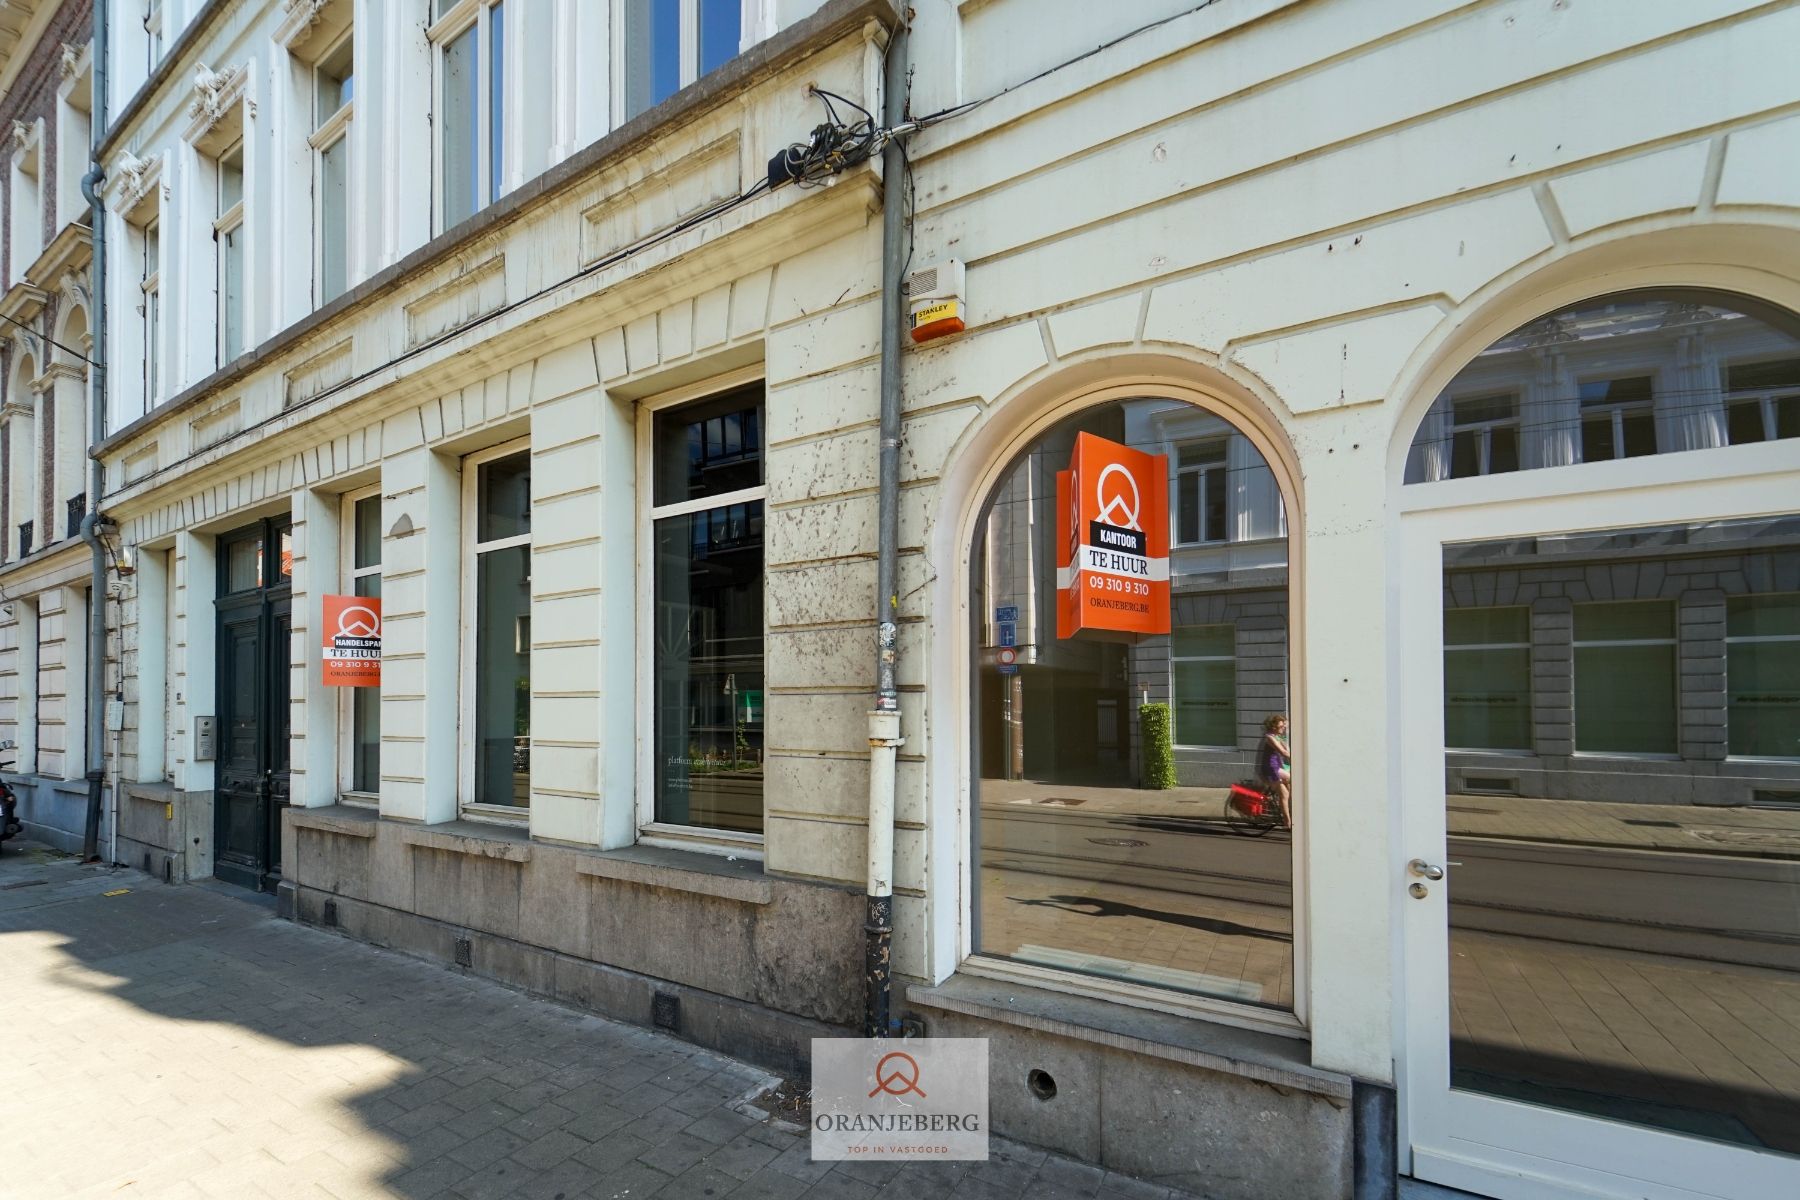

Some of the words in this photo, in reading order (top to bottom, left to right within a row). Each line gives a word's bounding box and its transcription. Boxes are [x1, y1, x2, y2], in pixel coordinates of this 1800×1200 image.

[919, 304, 948, 318] STANLEY
[1100, 529, 1137, 549] KANTOOR
[1089, 550, 1108, 568] TE
[1111, 554, 1149, 575] HUUR
[1089, 576, 1104, 590] 09
[1106, 577, 1122, 592] 310
[1125, 580, 1131, 593] 9
[1133, 582, 1149, 596] 310
[1090, 597, 1150, 614] ORANJEBERG.BE
[330, 648, 348, 657] TE
[330, 660, 343, 668] 09
